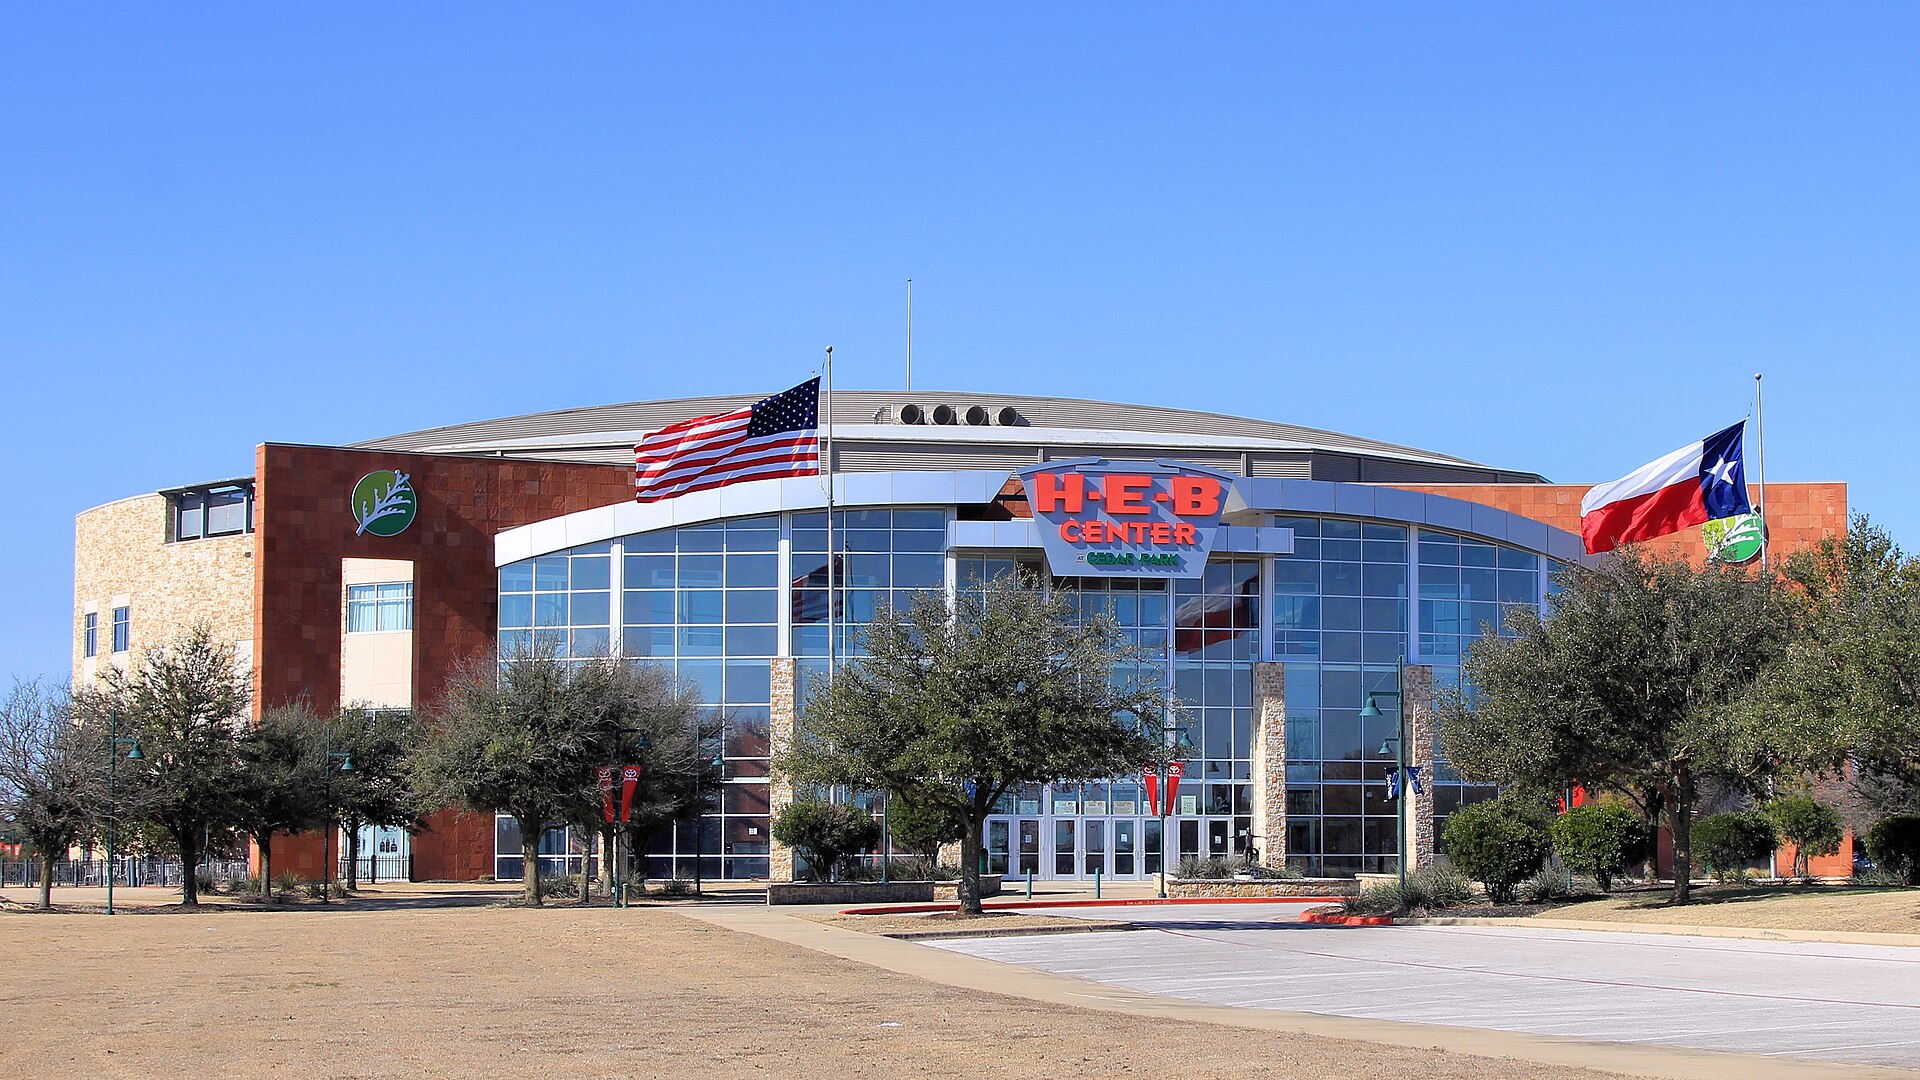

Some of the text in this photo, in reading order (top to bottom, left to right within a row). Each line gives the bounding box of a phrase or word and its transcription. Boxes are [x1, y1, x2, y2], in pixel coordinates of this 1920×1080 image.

[1035, 474, 1221, 515] H-E-B
[1060, 520, 1196, 545] CENTER
[1086, 552, 1135, 565] CEDAR
[1138, 553, 1179, 566] PARK
